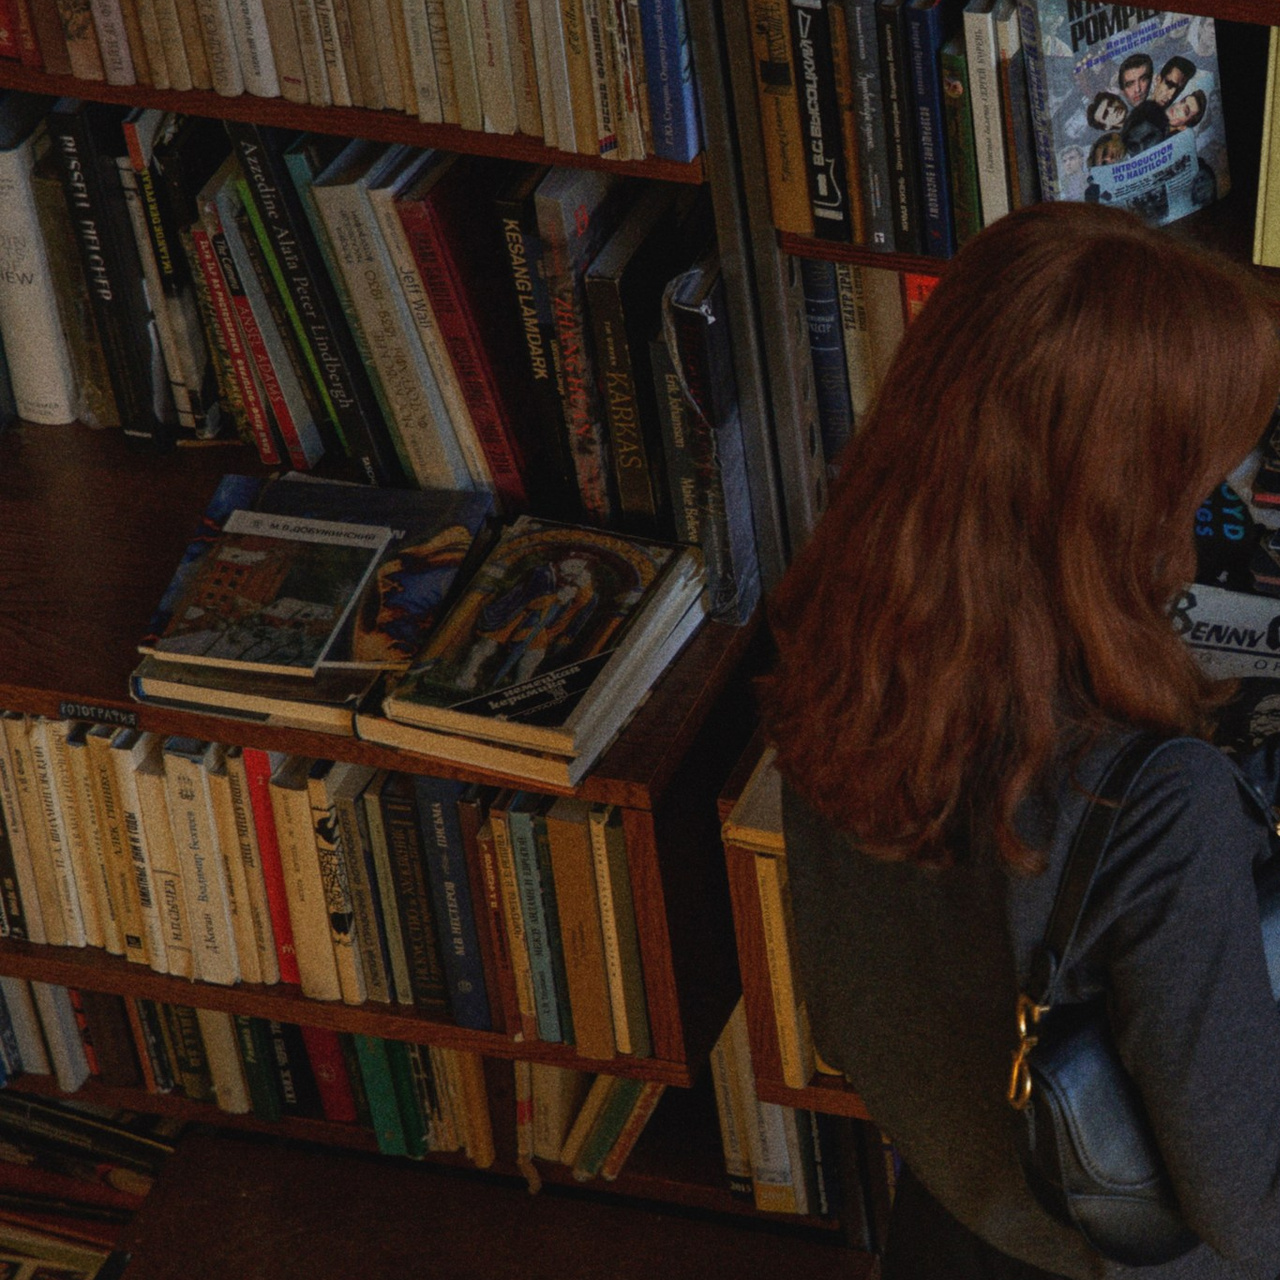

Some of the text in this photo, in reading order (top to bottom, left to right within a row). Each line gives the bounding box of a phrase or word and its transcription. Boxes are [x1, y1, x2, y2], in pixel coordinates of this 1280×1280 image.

[795, 36, 828, 138] ВЫСОЦКИЙ
[977, 67, 989, 103] СЕРГЕЙ
[1111, 141, 1175, 178] INTRODUCTION
[1111, 153, 1175, 184] TO NAUTILOGY
[238, 135, 357, 412] Azzedine Peter Lindbergh
[395, 261, 436, 332] Jeff Wall
[501, 216, 552, 381] KESANG LAMDARK
[235, 302, 284, 405] ANSEL ADAMS
[552, 295, 594, 438] ZHANG HUAN
[664, 372, 679, 394] Erik
[605, 368, 643, 472] KARKAS
[679, 476, 700, 543] Make Believe
[429, 800, 464, 935] НЕСТЕРОВ ПИСЬМА
